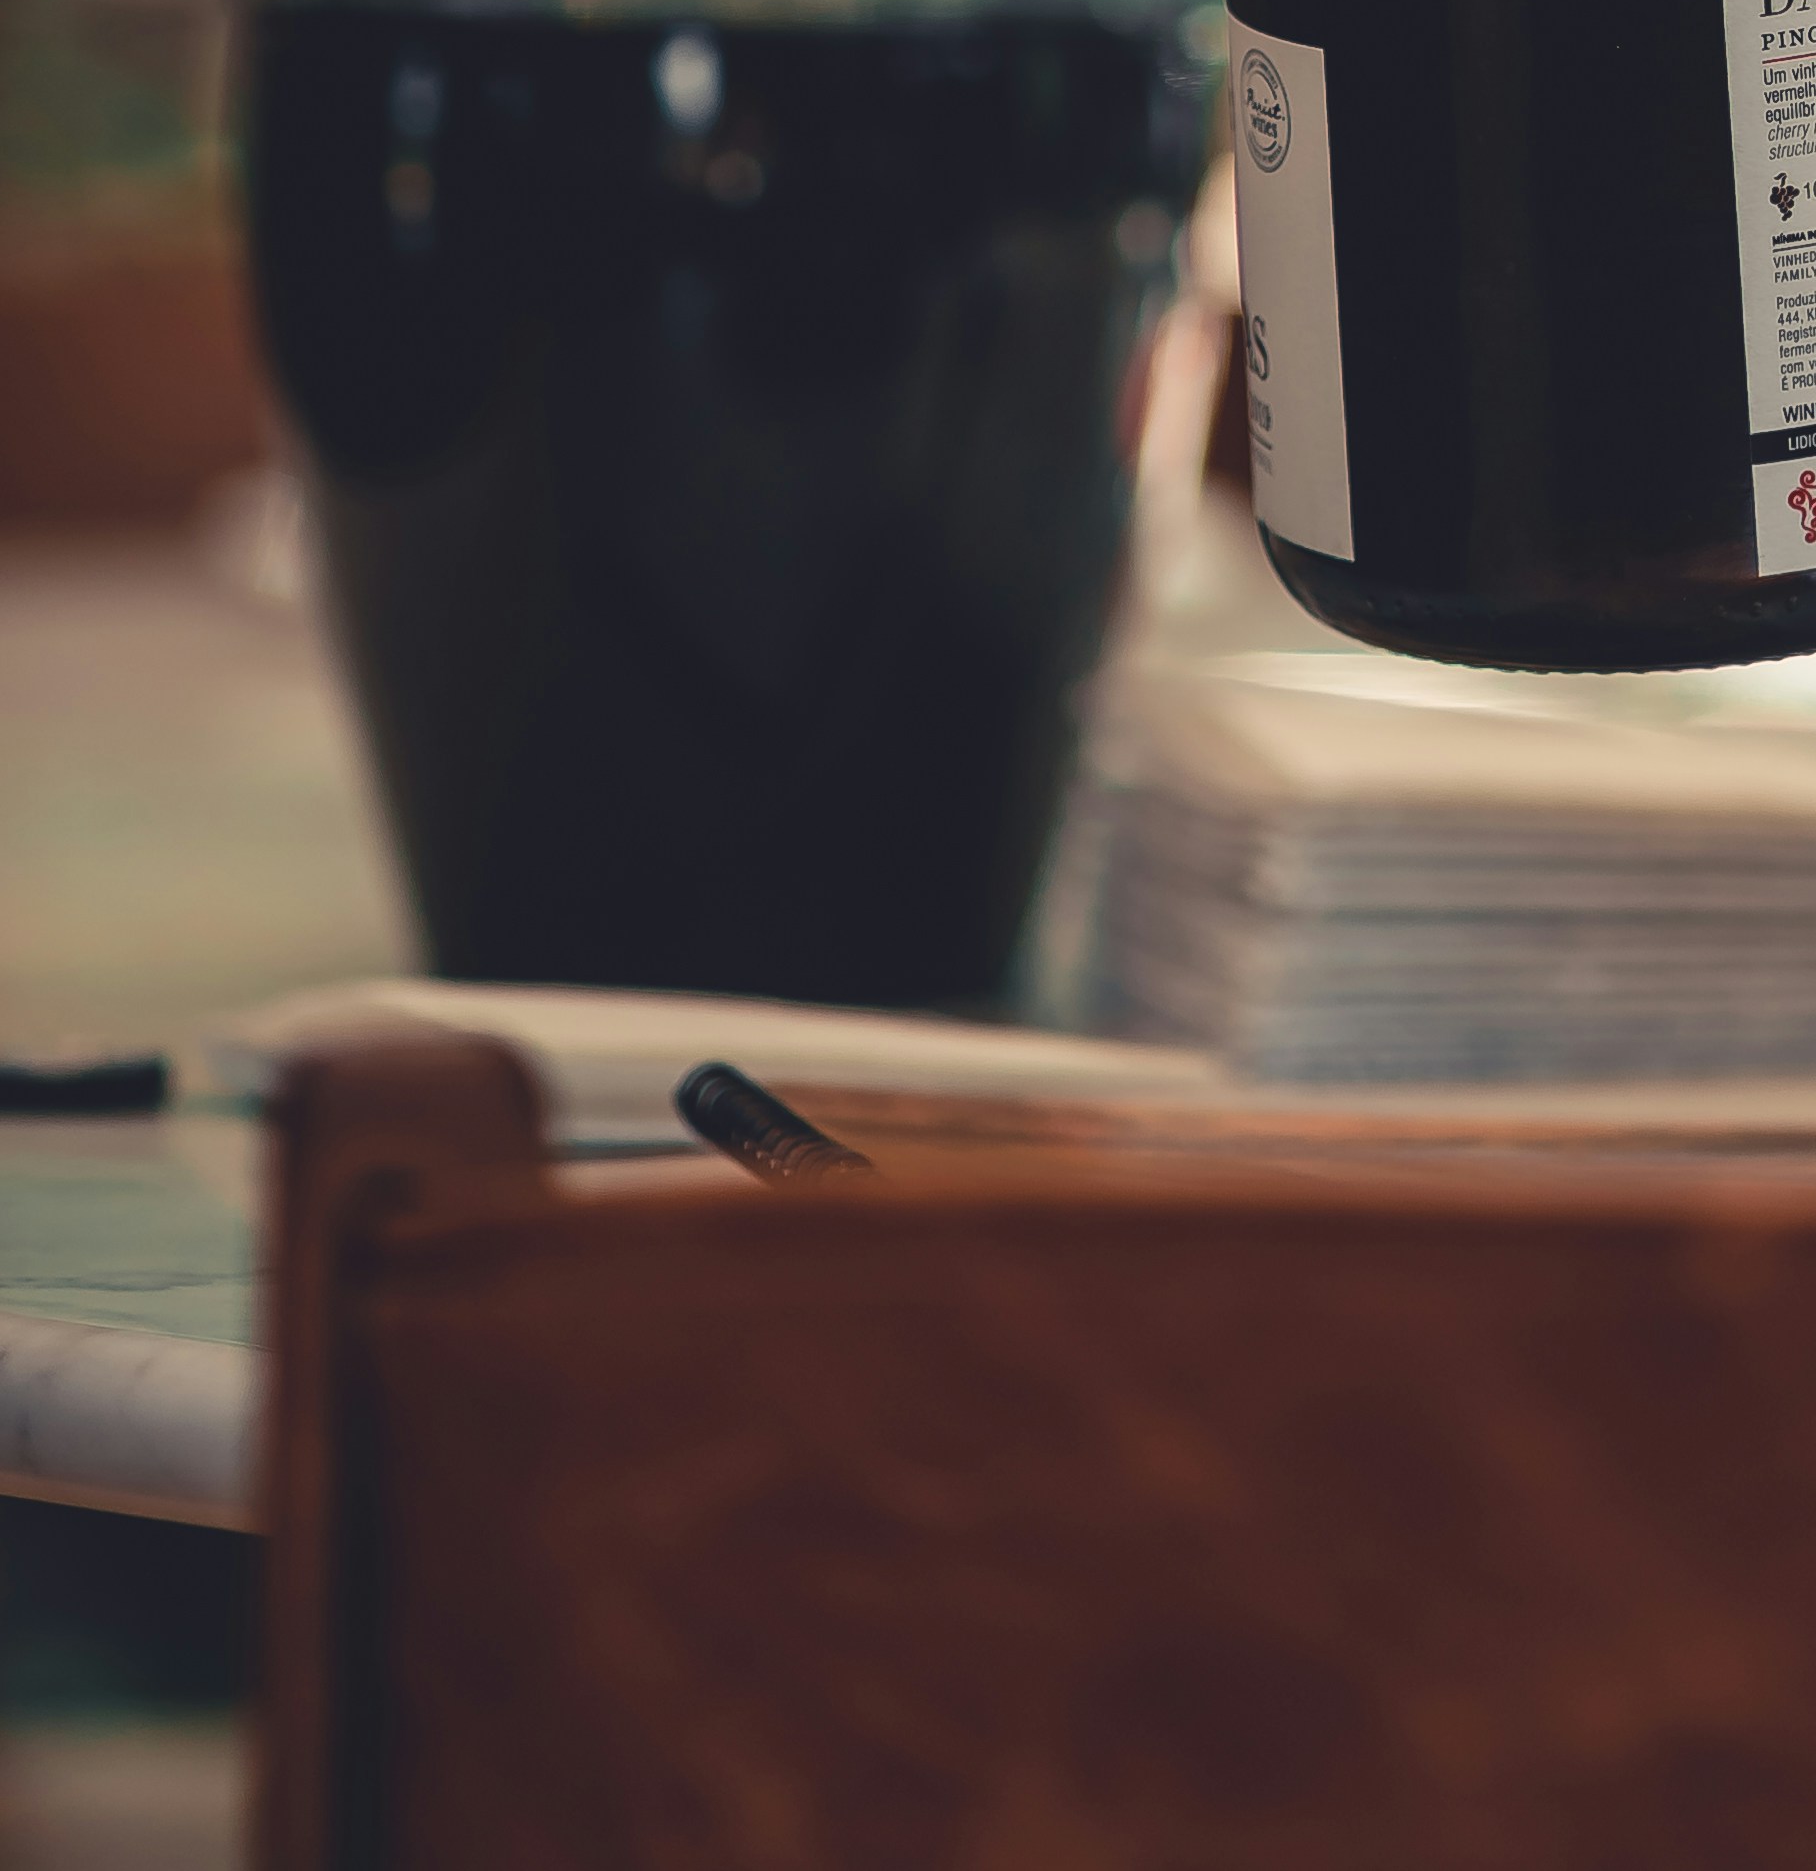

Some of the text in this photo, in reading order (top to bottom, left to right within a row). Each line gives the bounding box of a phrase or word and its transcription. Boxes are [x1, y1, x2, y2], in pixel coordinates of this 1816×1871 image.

[1763, 68, 1787, 86] Um
[1768, 122, 1811, 143] cherry
[1772, 232, 1806, 247] MÍNIMA
[1777, 310, 1804, 326] 444,
[1780, 361, 1804, 375] com
[1781, 376, 1789, 392] É
